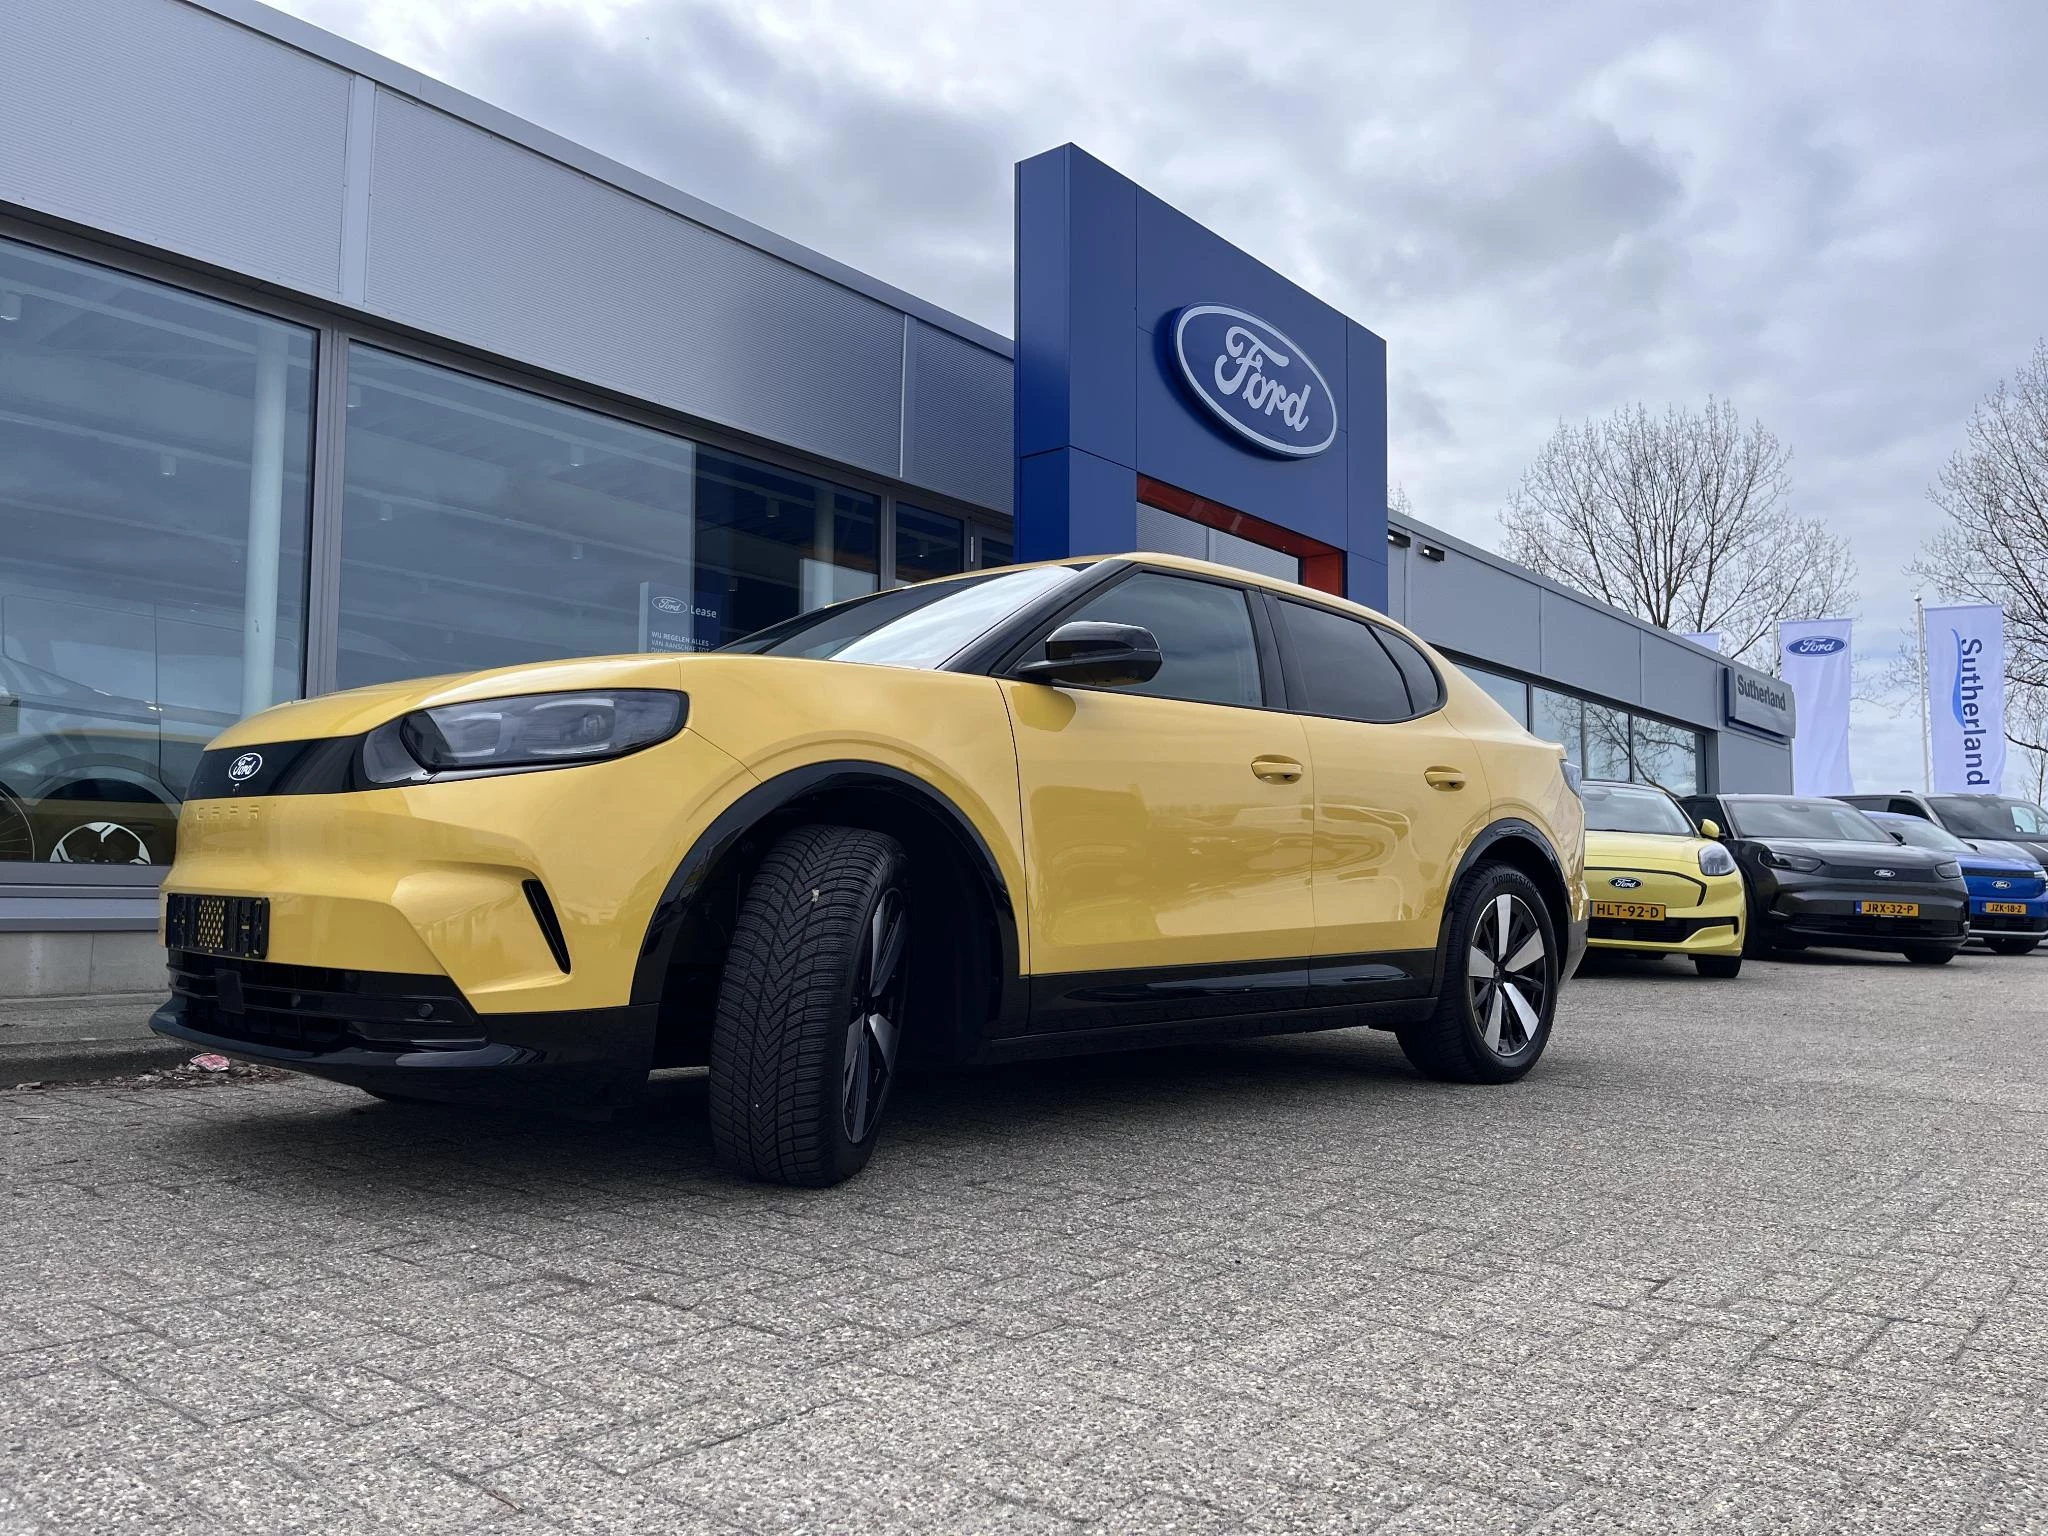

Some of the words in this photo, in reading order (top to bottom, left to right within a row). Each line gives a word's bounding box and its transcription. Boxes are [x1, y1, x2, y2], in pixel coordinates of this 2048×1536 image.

[1214, 326, 1311, 432] Ford
[658, 598, 681, 612] Ford
[690, 604, 717, 618] Lease
[663, 633, 690, 643] REGELEN
[691, 638, 709, 646] ALLES
[1799, 638, 1835, 653] Ford
[1737, 674, 1786, 711] Sutherland
[1961, 638, 1990, 786] Sutherland
[233, 757, 256, 776] Ford
[1596, 904, 1659, 918] HLT-92-D
[1865, 903, 1914, 914] JRX-32-P
[1990, 904, 2022, 913] JZK-18-Z
